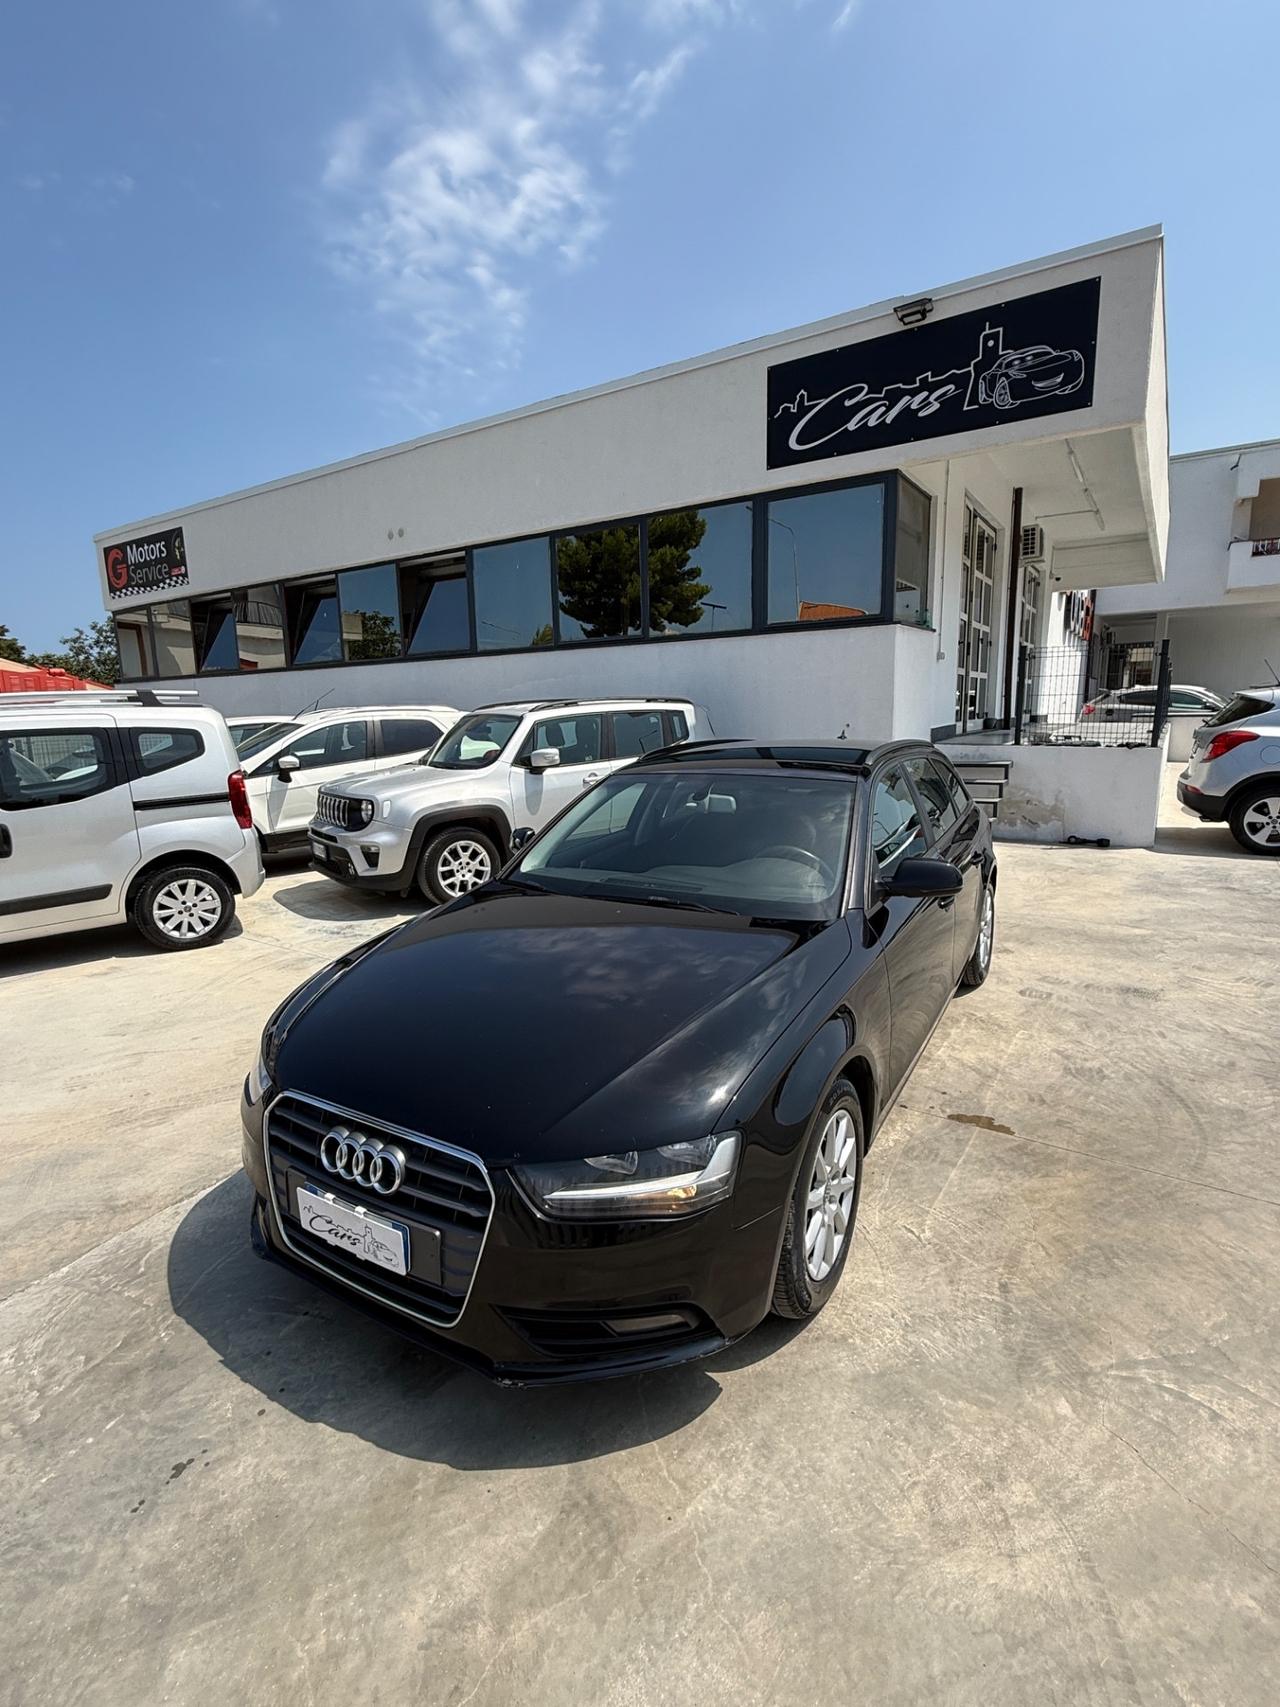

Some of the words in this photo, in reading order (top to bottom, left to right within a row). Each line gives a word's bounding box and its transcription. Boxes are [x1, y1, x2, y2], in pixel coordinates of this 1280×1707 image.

[788, 383, 963, 451] Cars
[107, 548, 128, 589] G
[127, 541, 167, 565] Motors
[129, 562, 169, 585] Service
[309, 1214, 362, 1246] Cars
